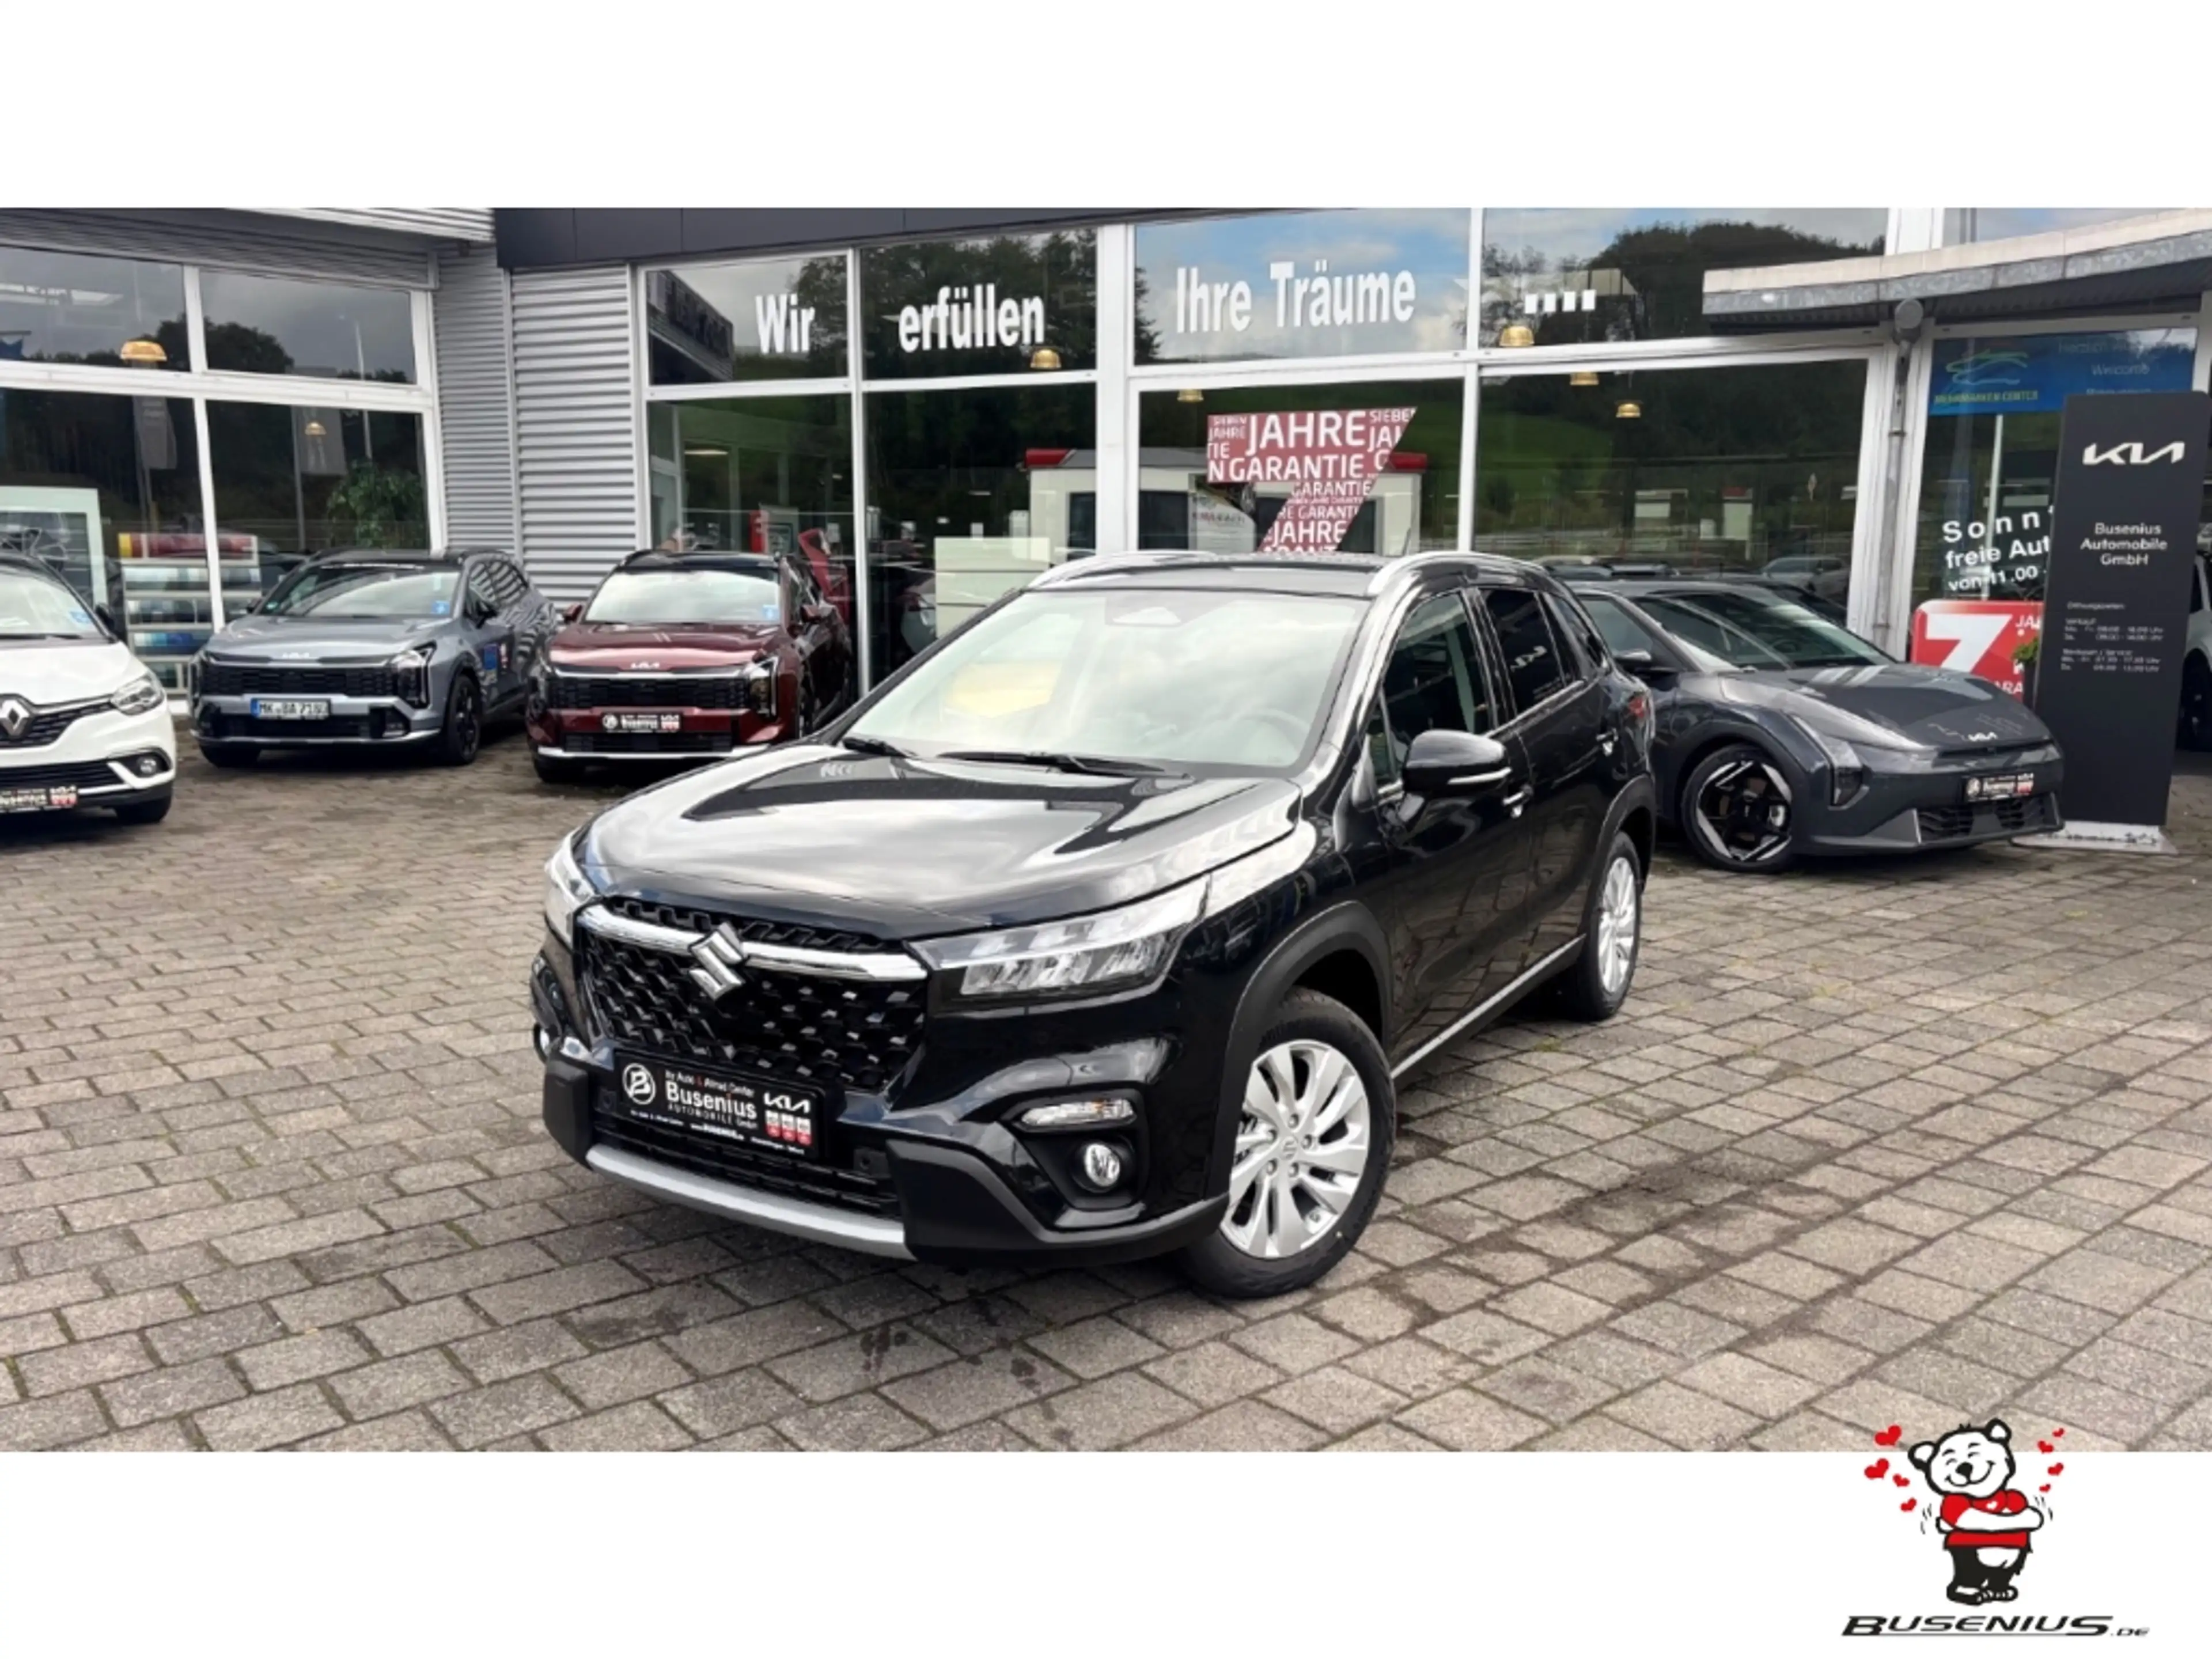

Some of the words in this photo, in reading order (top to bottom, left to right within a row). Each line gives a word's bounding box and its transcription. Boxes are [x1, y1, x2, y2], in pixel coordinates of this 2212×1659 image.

[755, 293, 815, 355] Wir
[899, 283, 1044, 353] erfüllen
[1176, 267, 1252, 334] Ihre
[1270, 259, 1416, 328] Träume
[1245, 411, 1366, 456] JAHRE
[1229, 454, 1363, 481] GARANTIE
[1272, 520, 1347, 547] JAHRE
[2095, 522, 2161, 535] Busenius
[2080, 538, 2168, 550] Automobile
[1946, 545, 2001, 569] freie
[2100, 553, 2149, 566] GmbH
[1948, 577, 1982, 591] von
[665, 1080, 757, 1119] Busenius
